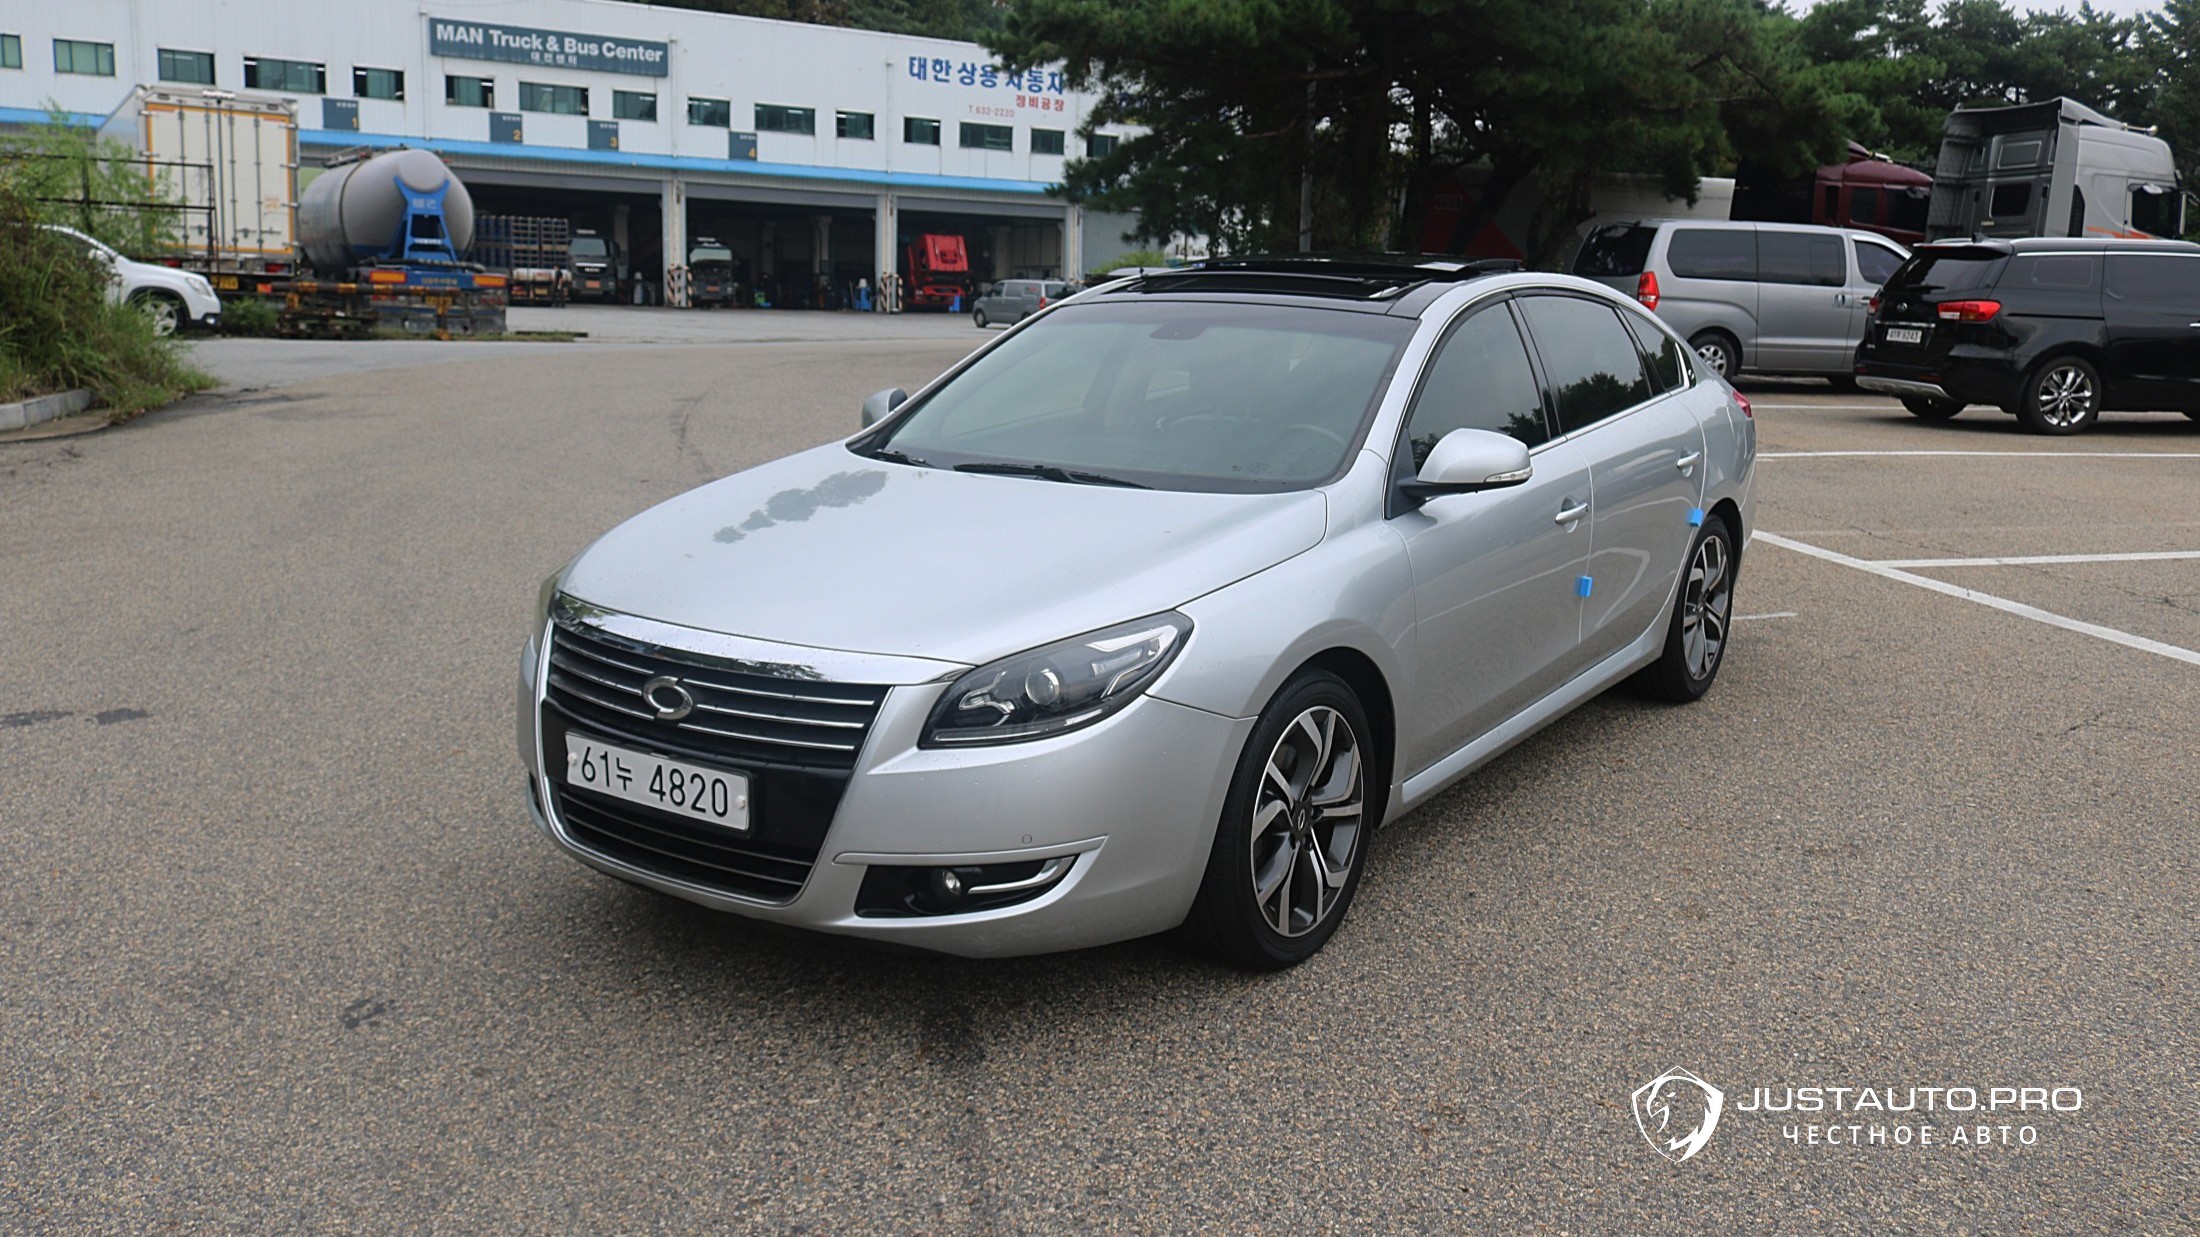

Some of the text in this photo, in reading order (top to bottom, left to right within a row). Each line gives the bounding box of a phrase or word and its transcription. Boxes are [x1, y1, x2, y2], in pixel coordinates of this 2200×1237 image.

[436, 24, 663, 62] MAN Truck & Bus Center
[908, 56, 952, 83] 대한
[957, 62, 998, 88] 상용
[1015, 94, 1065, 112] 정비공장
[513, 129, 521, 141] 2
[610, 136, 617, 148] 3
[581, 746, 728, 817] 61누 4820
